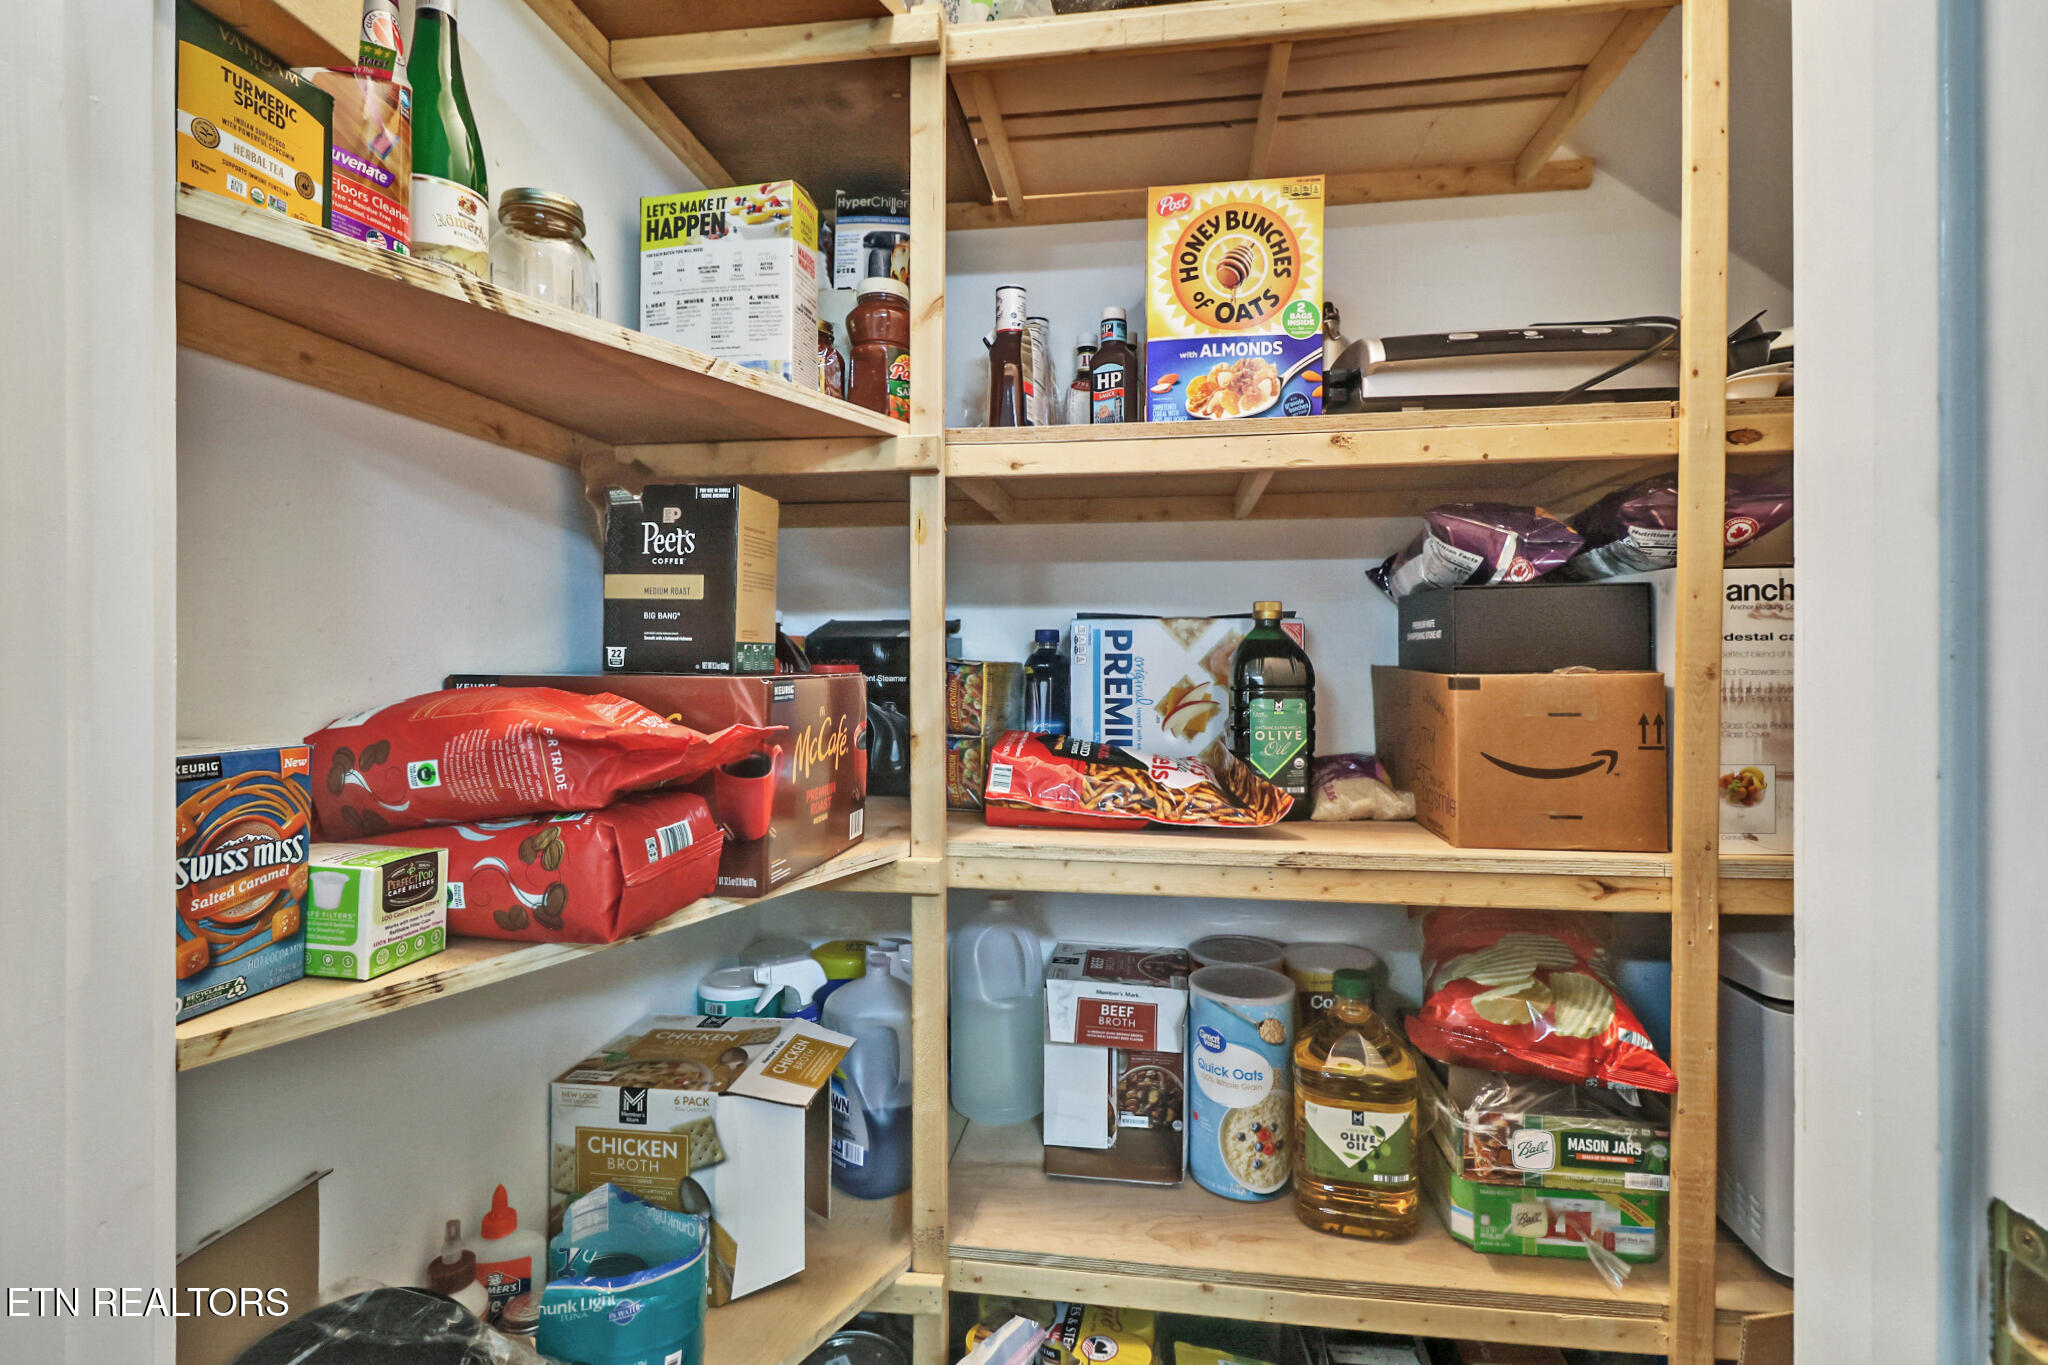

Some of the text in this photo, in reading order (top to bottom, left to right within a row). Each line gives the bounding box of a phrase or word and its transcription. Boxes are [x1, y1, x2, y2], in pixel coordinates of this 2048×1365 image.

[220, 65, 298, 124] TURMERIC
[233, 91, 286, 130] SPICED
[255, 126, 286, 150] SUPERFOOD
[191, 159, 200, 171] 15
[233, 142, 267, 170] HERBAL
[268, 161, 285, 179] TEA
[353, 200, 392, 222] Residue Free
[646, 196, 728, 219] LET'S MAKE IT
[838, 196, 907, 213] HyperChiller
[1159, 194, 1189, 215] Post
[646, 211, 726, 243] HAPPEN
[1179, 209, 1293, 284] HONEY BUNCHES
[1192, 287, 1281, 324] of OATS
[1296, 302, 1306, 313] 2
[1287, 318, 1316, 327] INSIDE
[1289, 311, 1313, 320] BAGS
[1179, 340, 1283, 360] with ALMONDS
[1096, 371, 1122, 390] HP
[1099, 390, 1116, 400] SAUCE
[641, 521, 696, 556] Peet's
[1631, 529, 1671, 539] Nutrition
[651, 557, 685, 565] COFFEE
[1458, 552, 1479, 564] Facts
[643, 587, 691, 596] MEDIUM ROAST
[1725, 577, 1795, 602] anch
[643, 611, 656, 620] BIG
[610, 649, 622, 658] 22
[877, 674, 908, 683] Steamer
[1255, 730, 1303, 741] OLIVE
[792, 713, 848, 785] McCafé
[1263, 741, 1292, 756] Oil
[283, 757, 308, 768] New
[550, 749, 568, 792] TRADE
[805, 780, 837, 804] PREMIUM
[810, 796, 833, 816] ROAST
[175, 847, 249, 892] SWISS
[190, 864, 290, 913] Salted Caramel
[408, 878, 434, 891] FILTERS
[381, 914, 393, 922] 100
[247, 957, 264, 970] HOT
[185, 982, 231, 1002] RECYCLABLE
[1100, 1003, 1135, 1018] BEEF
[1098, 1016, 1136, 1028] BROTH
[654, 1031, 740, 1042] CHICKEN
[1200, 1029, 1221, 1043] Great
[1205, 1040, 1221, 1050] Value
[772, 1039, 811, 1075] CHICKEN
[792, 1048, 815, 1071] BROTH
[1197, 1057, 1264, 1081] Quick Oats
[1216, 1078, 1263, 1091] Whole Grain
[673, 1095, 710, 1106] 6 PACK
[1340, 1132, 1377, 1144] OLIVE
[587, 1135, 678, 1160] CHICKEN
[1346, 1141, 1368, 1152] OIL
[1517, 1140, 1550, 1159] Ball
[1567, 1137, 1642, 1156] MASON JARS
[607, 1157, 659, 1173] BROTH
[1516, 1211, 1543, 1228] Ball
[580, 1294, 616, 1313] Light
[617, 1304, 641, 1318] WATER
[560, 1312, 589, 1323] TUNA
